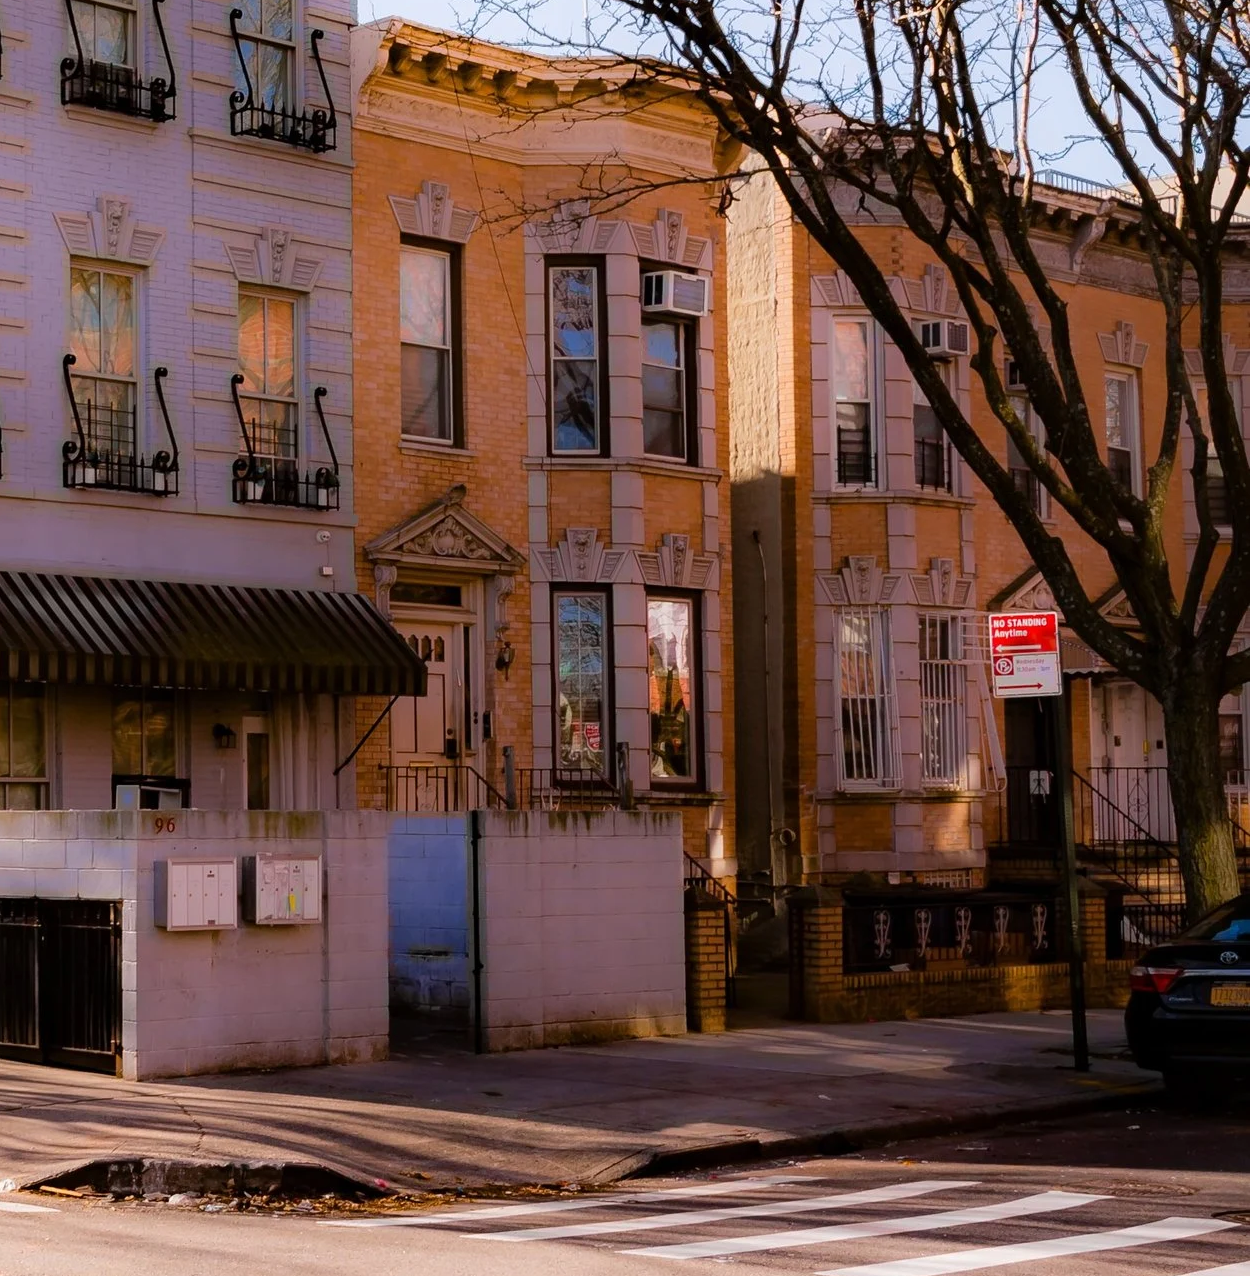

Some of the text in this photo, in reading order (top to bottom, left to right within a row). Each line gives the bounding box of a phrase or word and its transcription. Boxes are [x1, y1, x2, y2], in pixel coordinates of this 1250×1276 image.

[993, 617, 1047, 628] NO STANDING
[994, 628, 1028, 639] Anytime
[155, 817, 175, 834] 96
